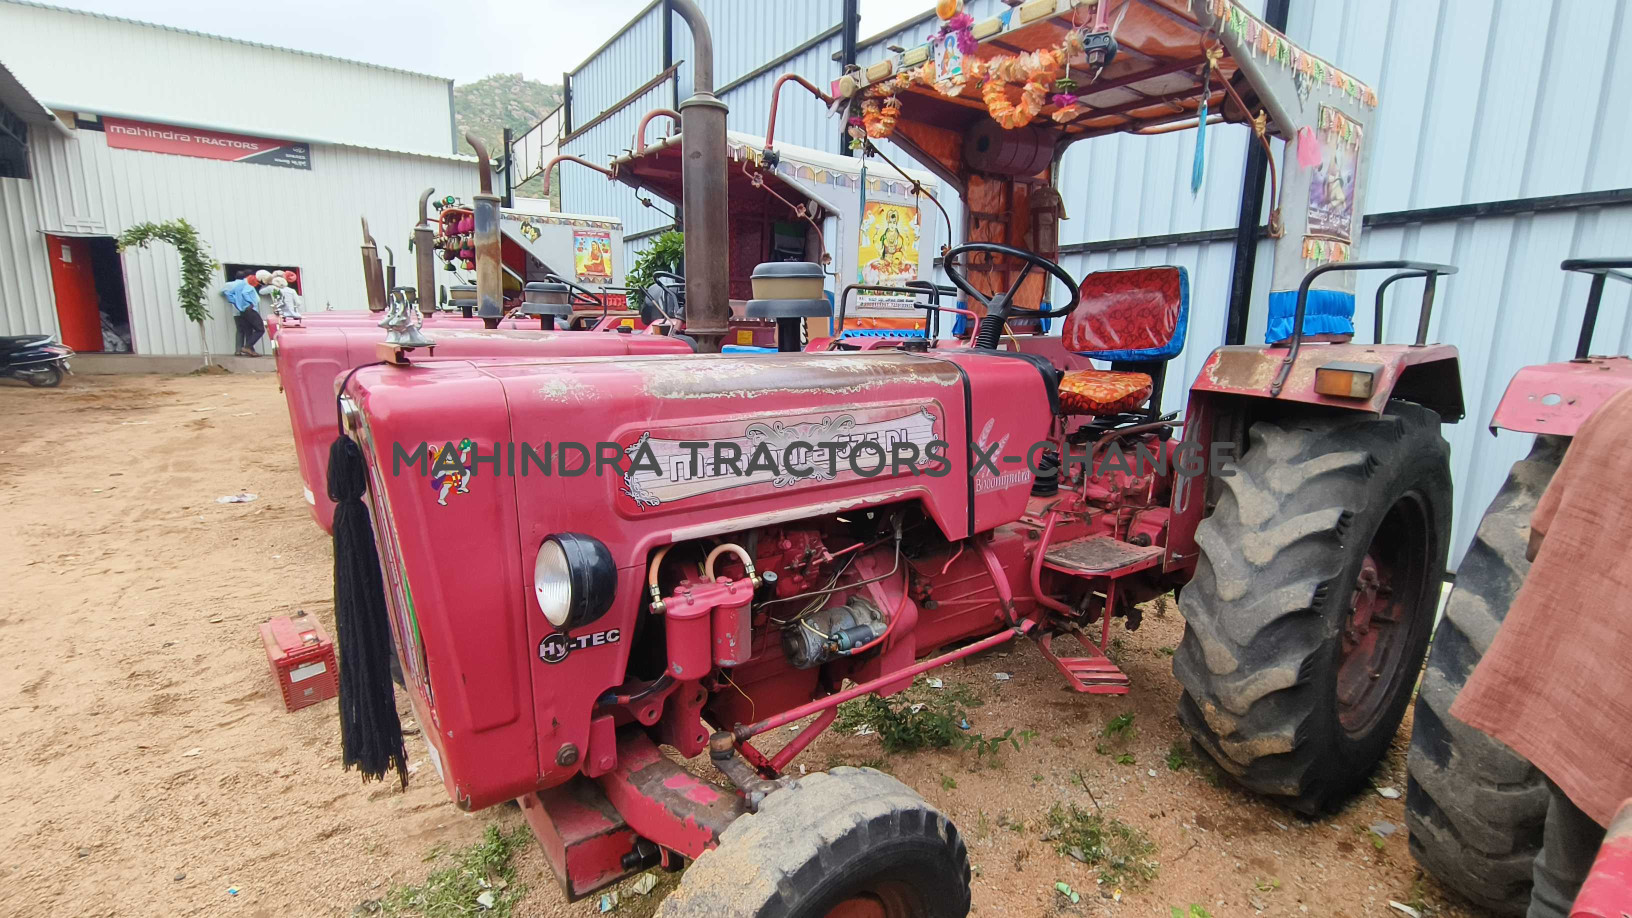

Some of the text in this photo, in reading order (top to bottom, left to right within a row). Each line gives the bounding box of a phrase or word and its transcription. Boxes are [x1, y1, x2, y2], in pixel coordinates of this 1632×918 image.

[110, 125, 259, 151] mahindra TRACTORS
[540, 629, 620, 658] Hy-TEC
